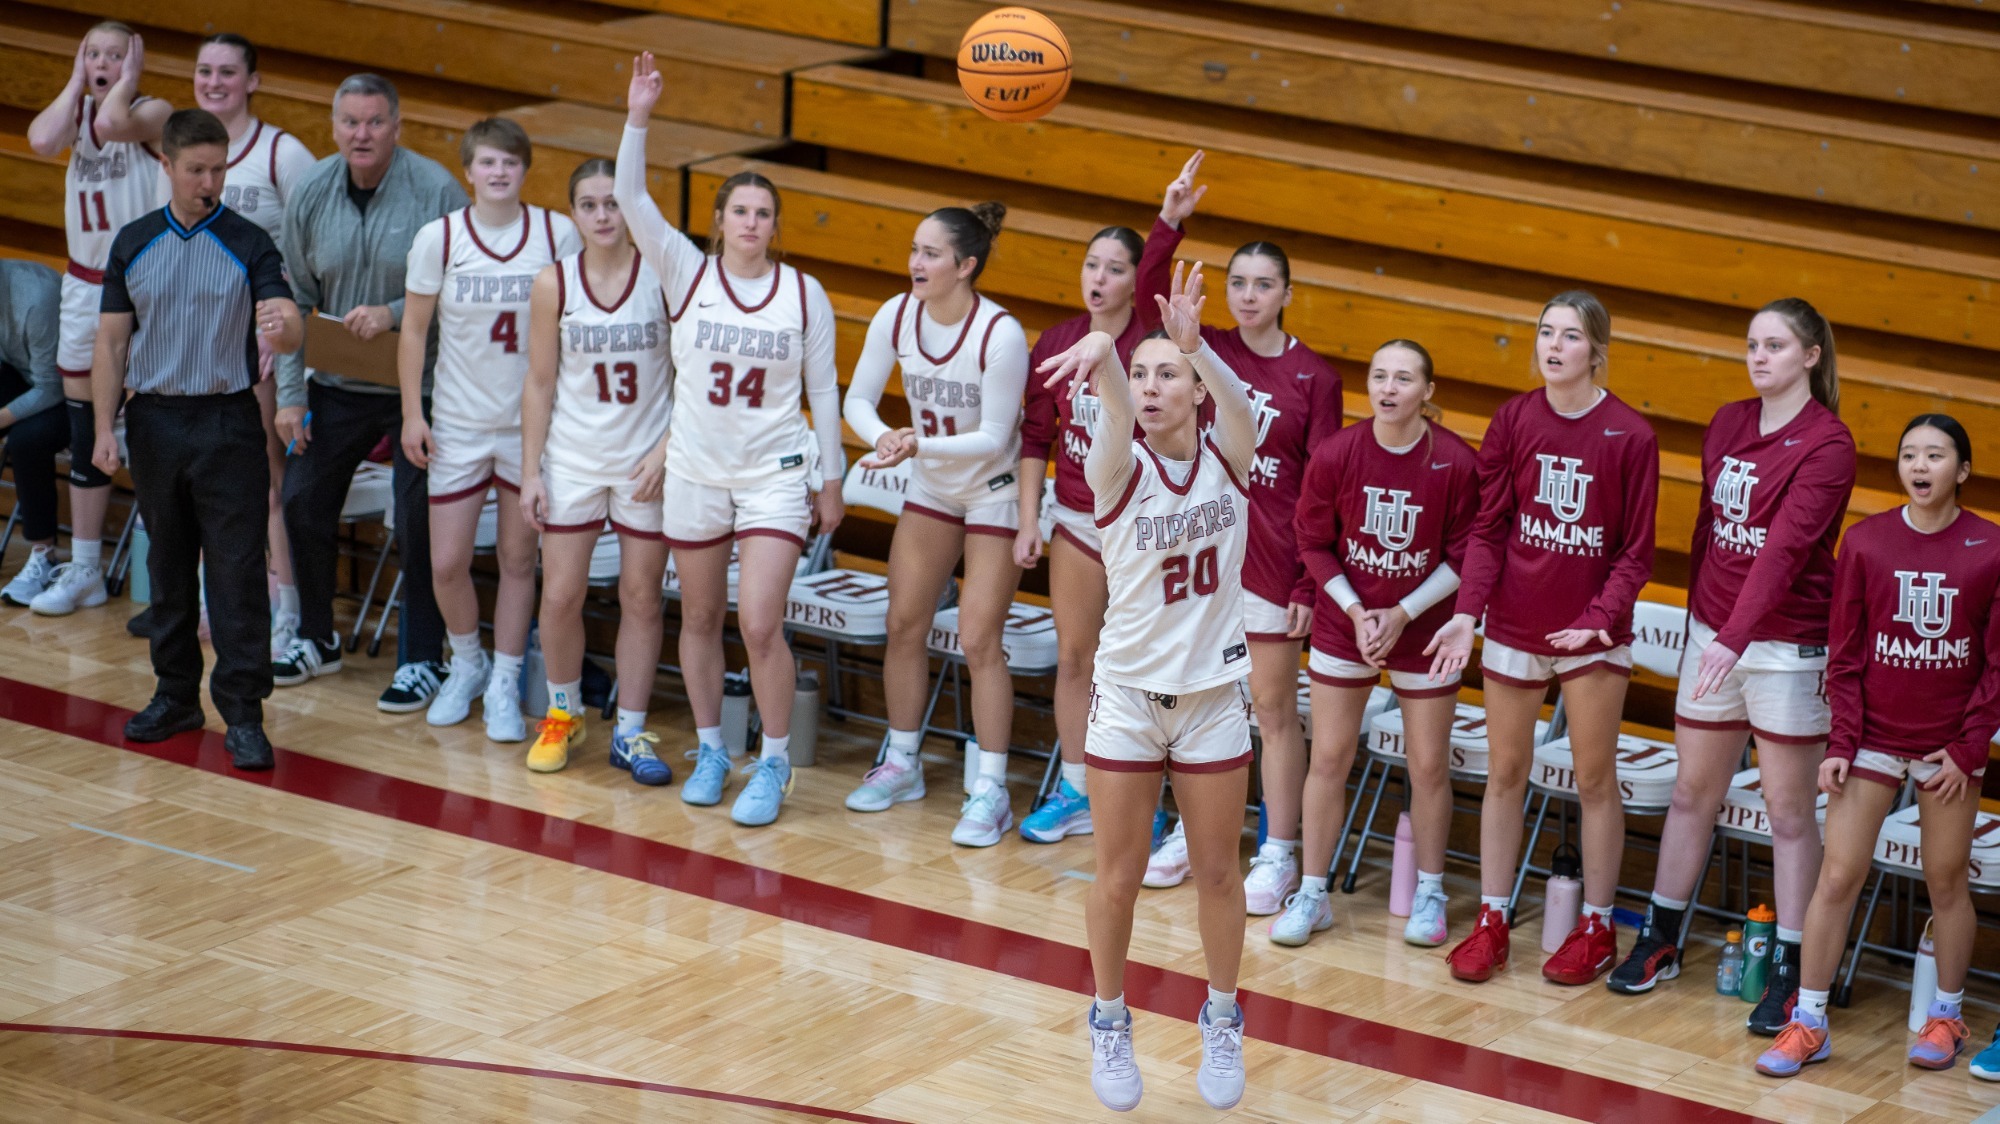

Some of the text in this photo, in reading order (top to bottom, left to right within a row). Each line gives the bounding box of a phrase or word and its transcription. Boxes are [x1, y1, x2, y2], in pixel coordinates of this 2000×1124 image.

[971, 42, 1045, 65] Wilson
[79, 191, 111, 232] 11
[455, 275, 534, 303] PIPER
[490, 311, 518, 353] 4
[568, 322, 660, 353] PIPERS
[695, 320, 790, 361] PIPERS
[594, 362, 638, 404] 13
[708, 361, 767, 408] 34
[1534, 453, 1594, 523] HU
[1711, 455, 1759, 524] HU
[1136, 494, 1236, 551] PIPERS
[1360, 486, 1423, 551] HU
[1521, 513, 1604, 547] HAMLINE
[1713, 516, 1767, 548] MLINE
[1346, 537, 1430, 571] HAMLINE
[1520, 533, 1602, 557] BASKETBALL
[1161, 545, 1219, 605] 20
[1345, 554, 1426, 579] ASKETBALL
[783, 601, 846, 629] IPERS
[1893, 570, 1959, 639] HU
[1875, 652, 1968, 670] BASKETBALL
[1876, 631, 1970, 660] HAMLINE
[1715, 804, 1769, 832] PIPE
